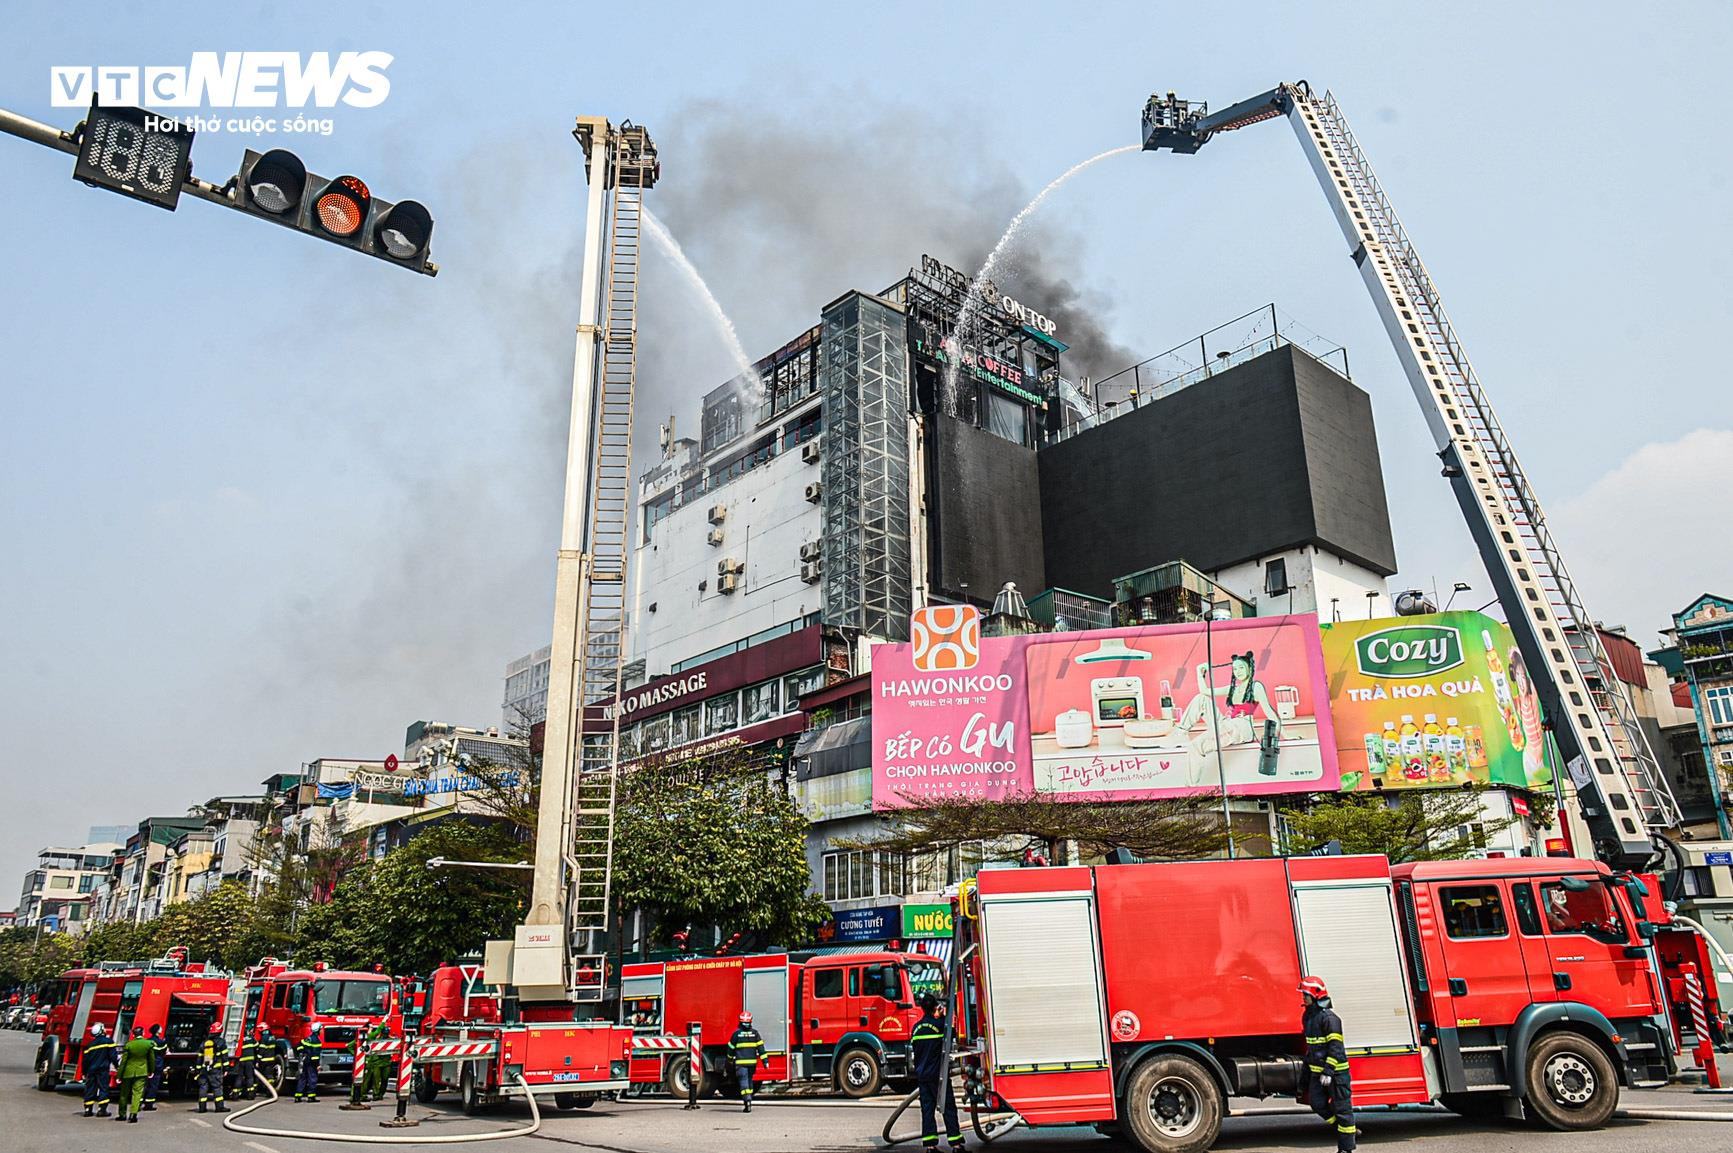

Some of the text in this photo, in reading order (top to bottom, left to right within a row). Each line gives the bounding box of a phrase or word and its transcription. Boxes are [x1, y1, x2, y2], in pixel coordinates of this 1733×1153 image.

[1003, 296, 1026, 321] ON
[1027, 308, 1057, 336] TOP
[977, 354, 1022, 385] COFFEE
[976, 367, 1043, 406] Entertainment
[1367, 637, 1448, 665] Cozy
[639, 671, 708, 709] MASSAGE
[881, 674, 1013, 697] HAWONKOO
[1347, 684, 1388, 702] TRÀ
[1391, 684, 1437, 699] HOA
[1440, 675, 1485, 697] QUẢ
[885, 731, 922, 761] BẾP
[886, 761, 1016, 779] CHỌN HAWONKOO
[1057, 755, 1148, 787] 고맙습니다
[914, 911, 953, 931] NƯỚC
